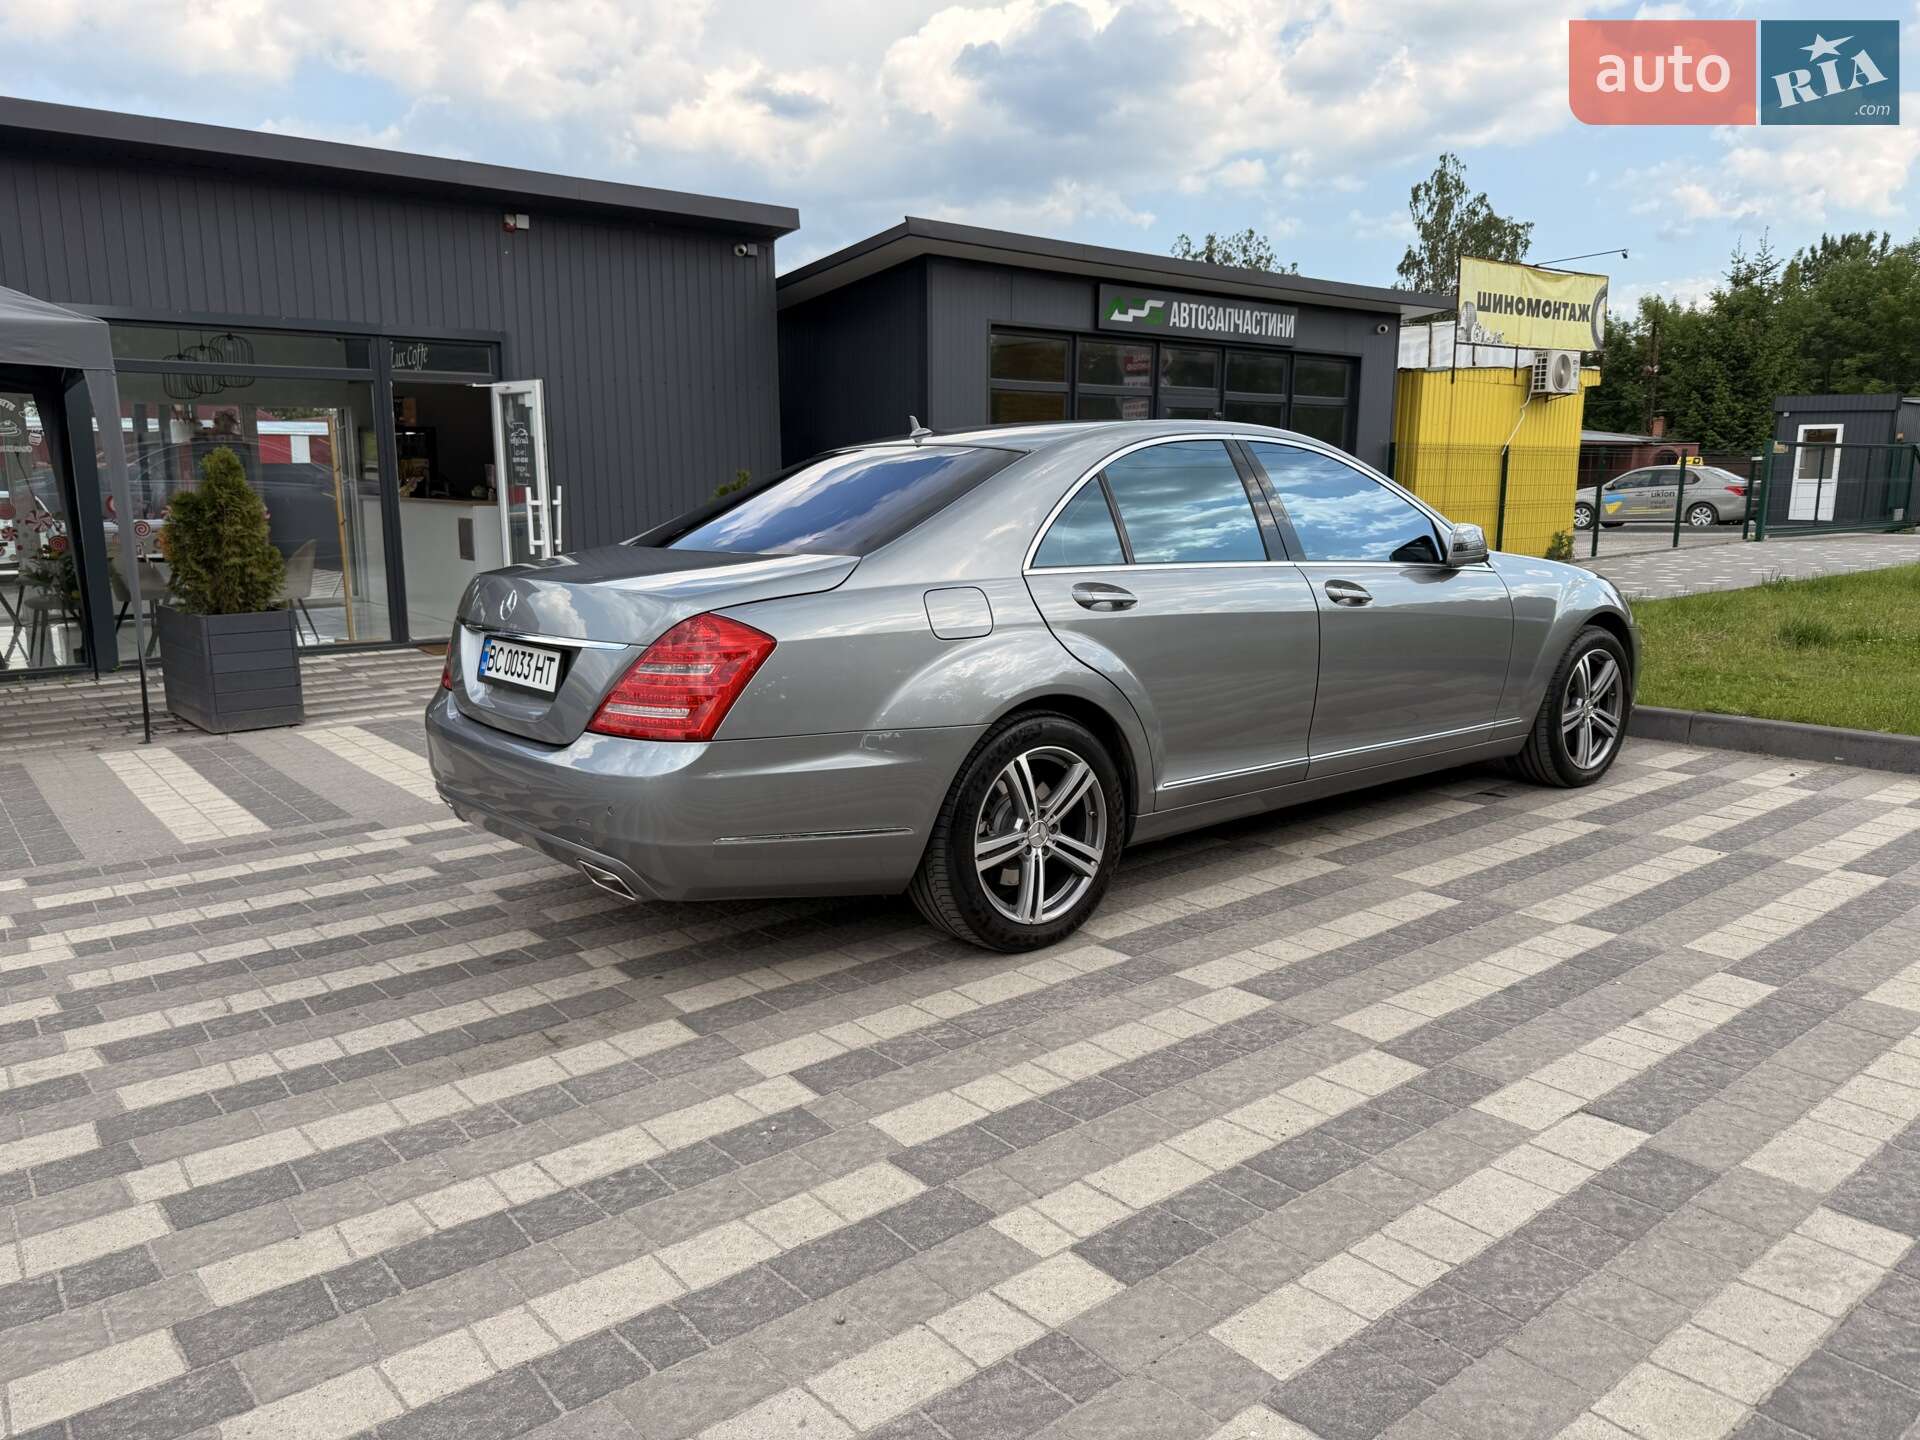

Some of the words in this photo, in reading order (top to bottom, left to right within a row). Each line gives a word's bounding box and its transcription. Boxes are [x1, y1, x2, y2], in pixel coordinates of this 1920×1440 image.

[1169, 301, 1295, 339] АВТОЗАПЧАСТИНИ
[1476, 291, 1591, 323] ШИНОМОНТАЖ
[486, 645, 505, 672] BC
[504, 649, 534, 681] 0033
[533, 654, 556, 686] HT
